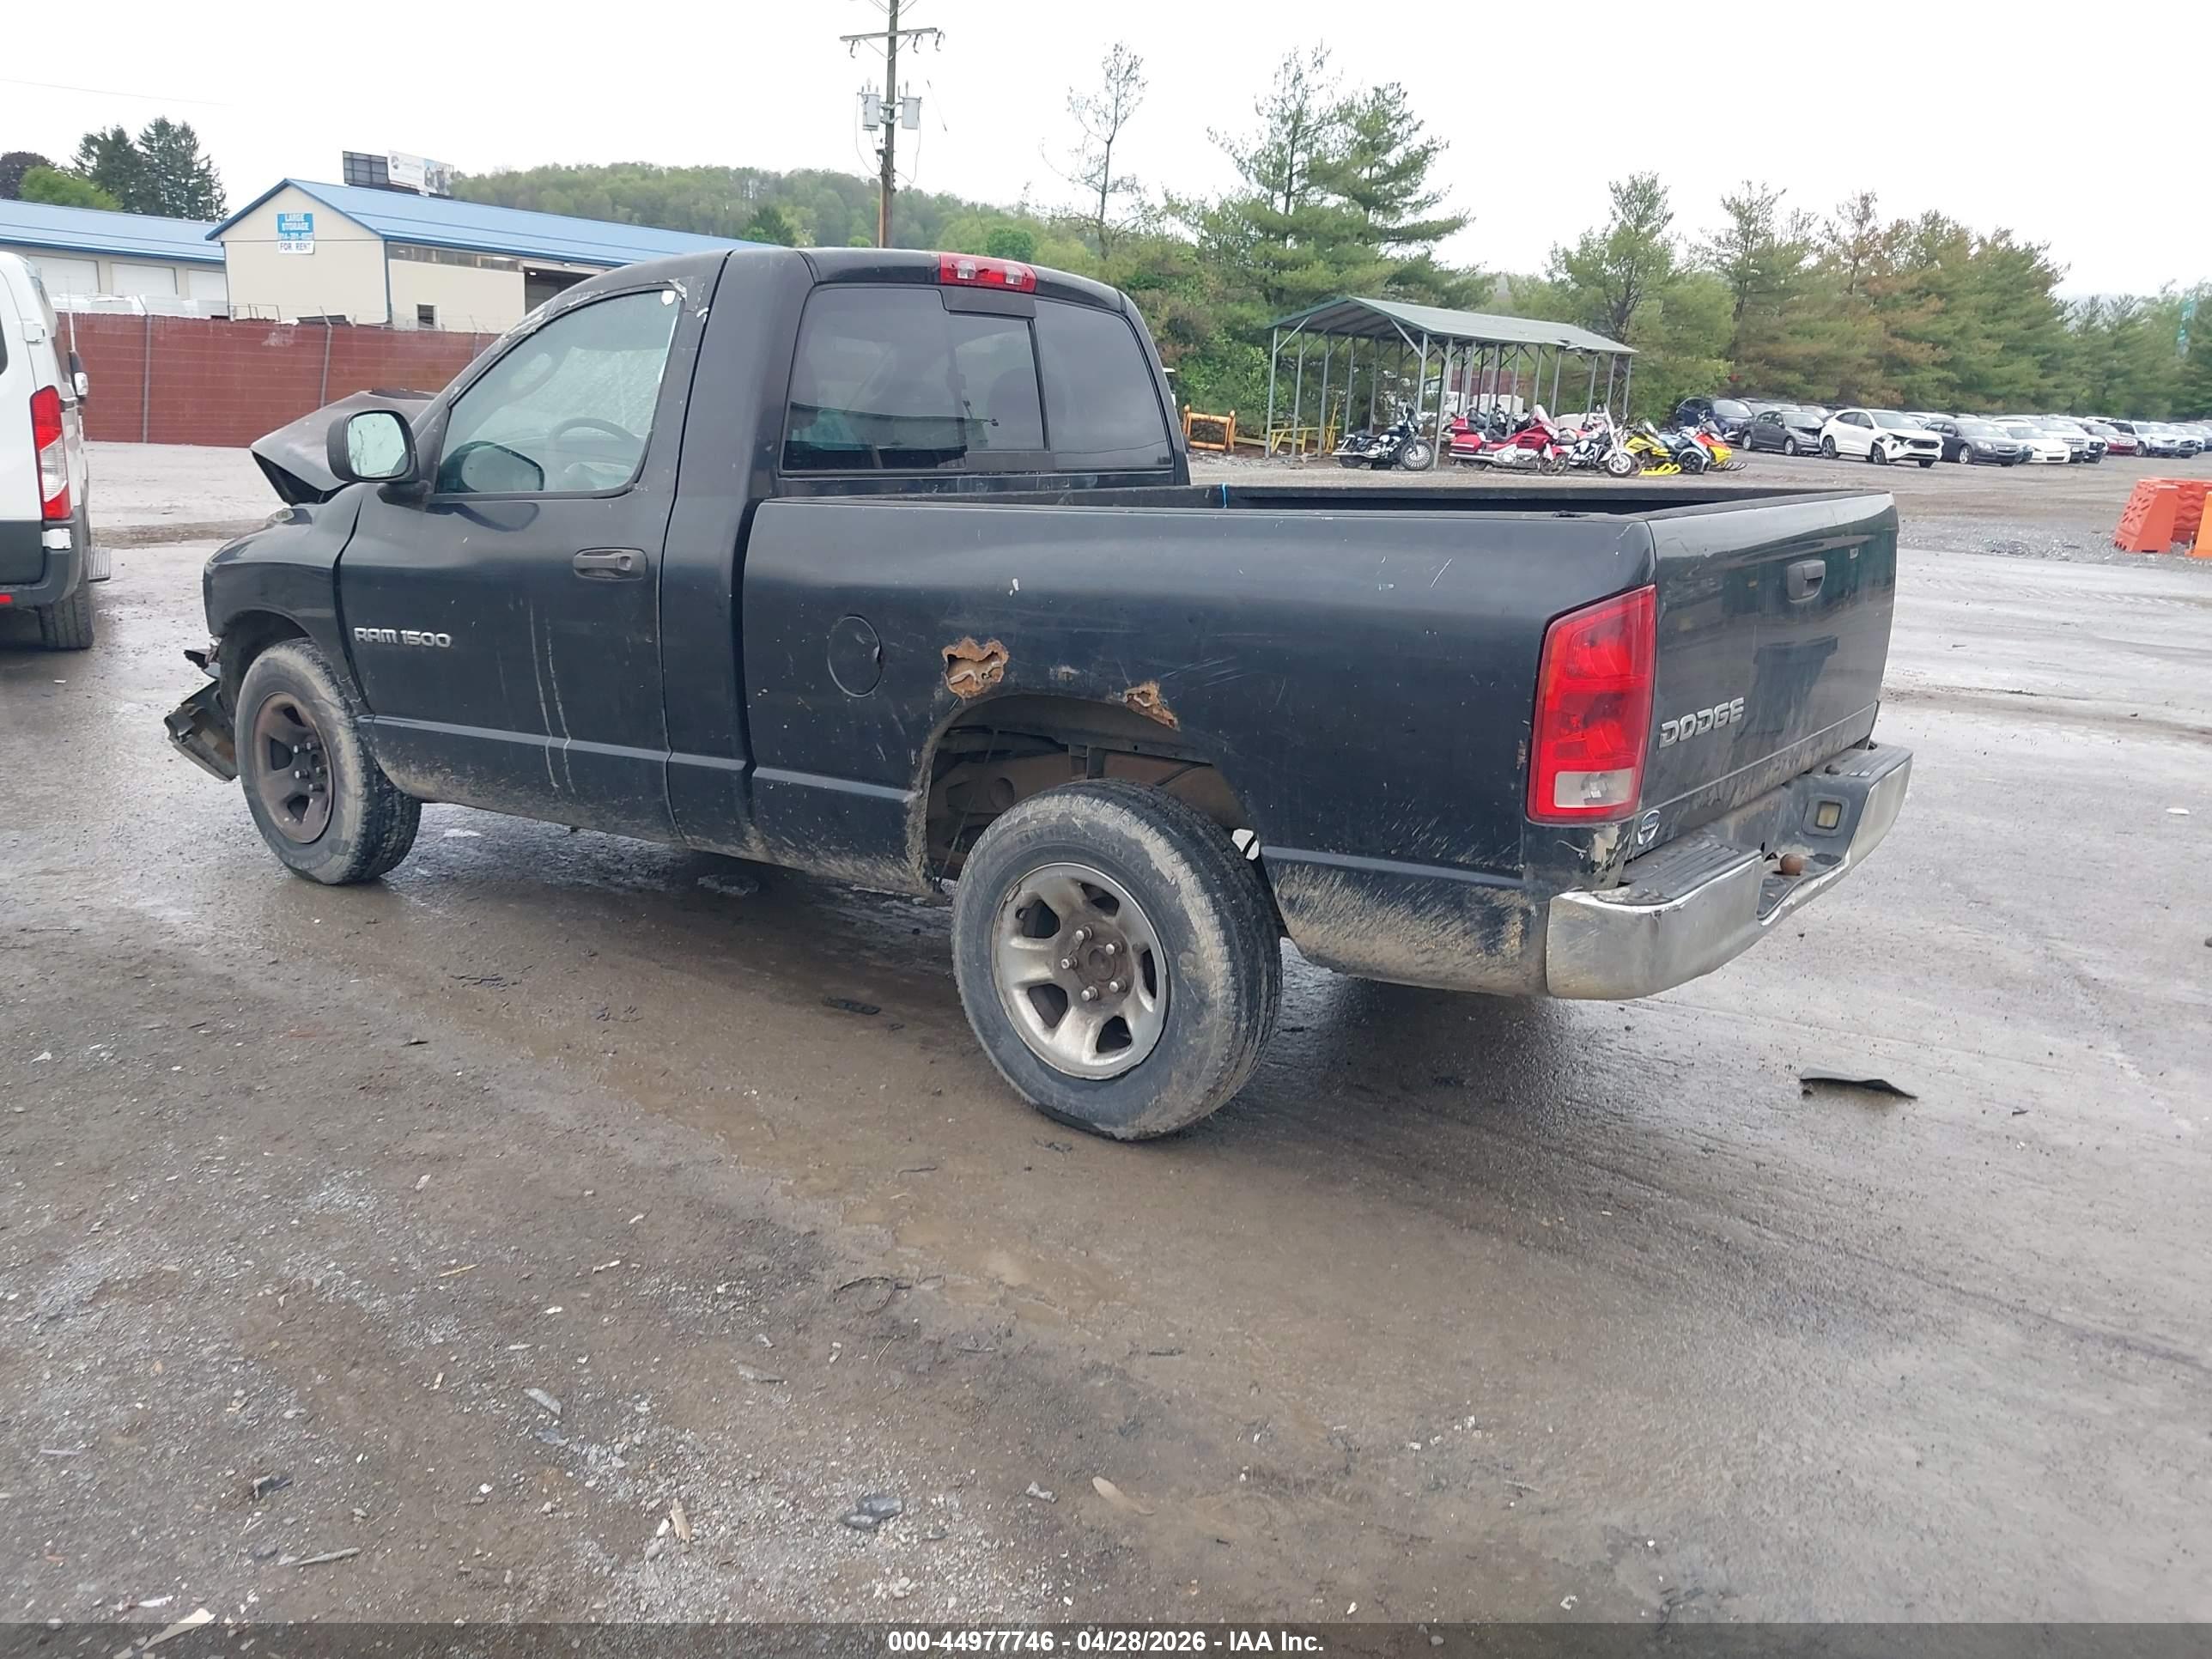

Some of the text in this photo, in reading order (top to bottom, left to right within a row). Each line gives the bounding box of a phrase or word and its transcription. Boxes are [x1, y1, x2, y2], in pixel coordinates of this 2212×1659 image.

[282, 222, 310, 231] STORAGE
[280, 242, 311, 251] FOR RENT
[353, 627, 452, 647] RAM 1500
[1658, 696, 1745, 749] DODGE
